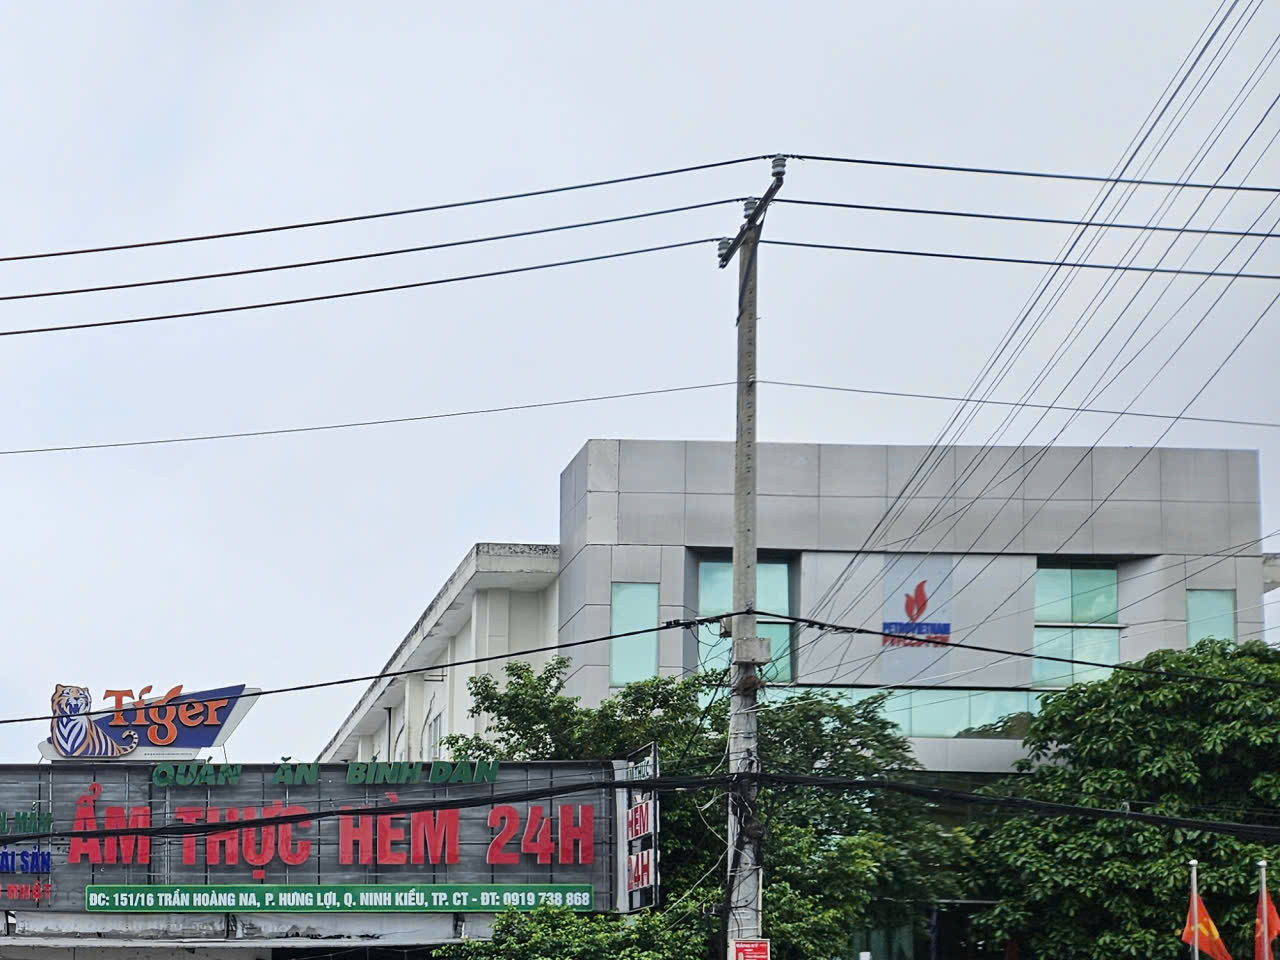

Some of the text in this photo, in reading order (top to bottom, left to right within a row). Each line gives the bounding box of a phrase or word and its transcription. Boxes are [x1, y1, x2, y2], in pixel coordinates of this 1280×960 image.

[103, 685, 228, 746] Tiger
[68, 783, 151, 865] ẨM
[175, 800, 312, 880] THỰC
[486, 805, 595, 865] 24H
[20, 844, 52, 873] SẢN
[89, 892, 110, 906] ĐC:
[113, 892, 154, 906] 151/16
[157, 888, 191, 906] TRẦN
[193, 889, 235, 906] HOÀNG
[239, 892, 260, 908] NA,
[265, 892, 275, 906] P.
[344, 892, 356, 907] Q.
[360, 892, 391, 906] NINH
[432, 892, 449, 906] TP.
[452, 892, 468, 906] CT
[480, 892, 500, 906] ĐT:
[503, 892, 535, 907] 0919
[538, 892, 563, 906] 738
[565, 892, 590, 906] 868
